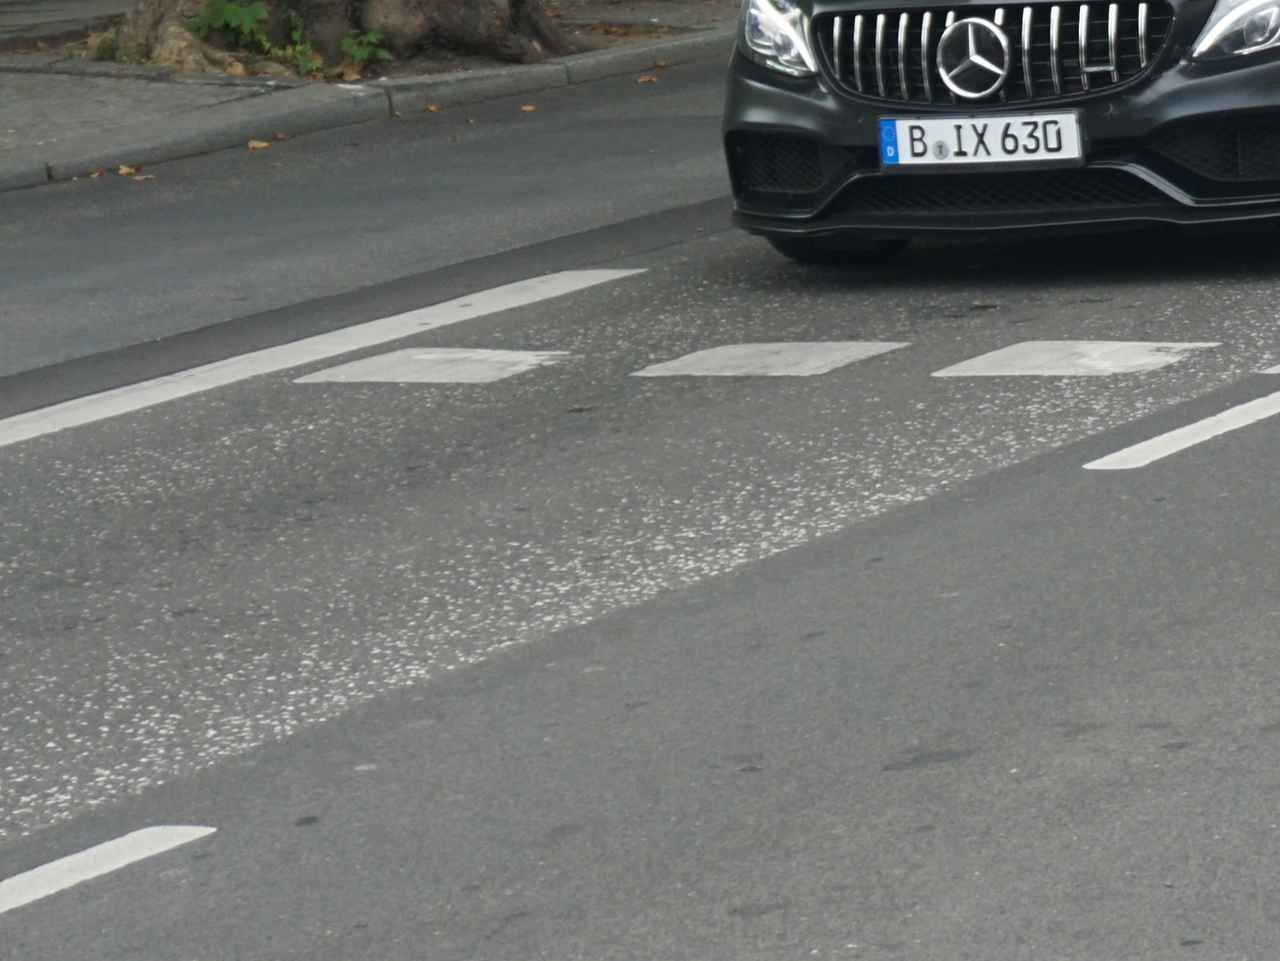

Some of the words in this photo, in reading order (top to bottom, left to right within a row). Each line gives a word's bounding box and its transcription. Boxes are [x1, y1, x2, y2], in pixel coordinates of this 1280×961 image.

[908, 125, 928, 158] B
[953, 122, 992, 156] IX
[1000, 119, 1063, 155] 630
